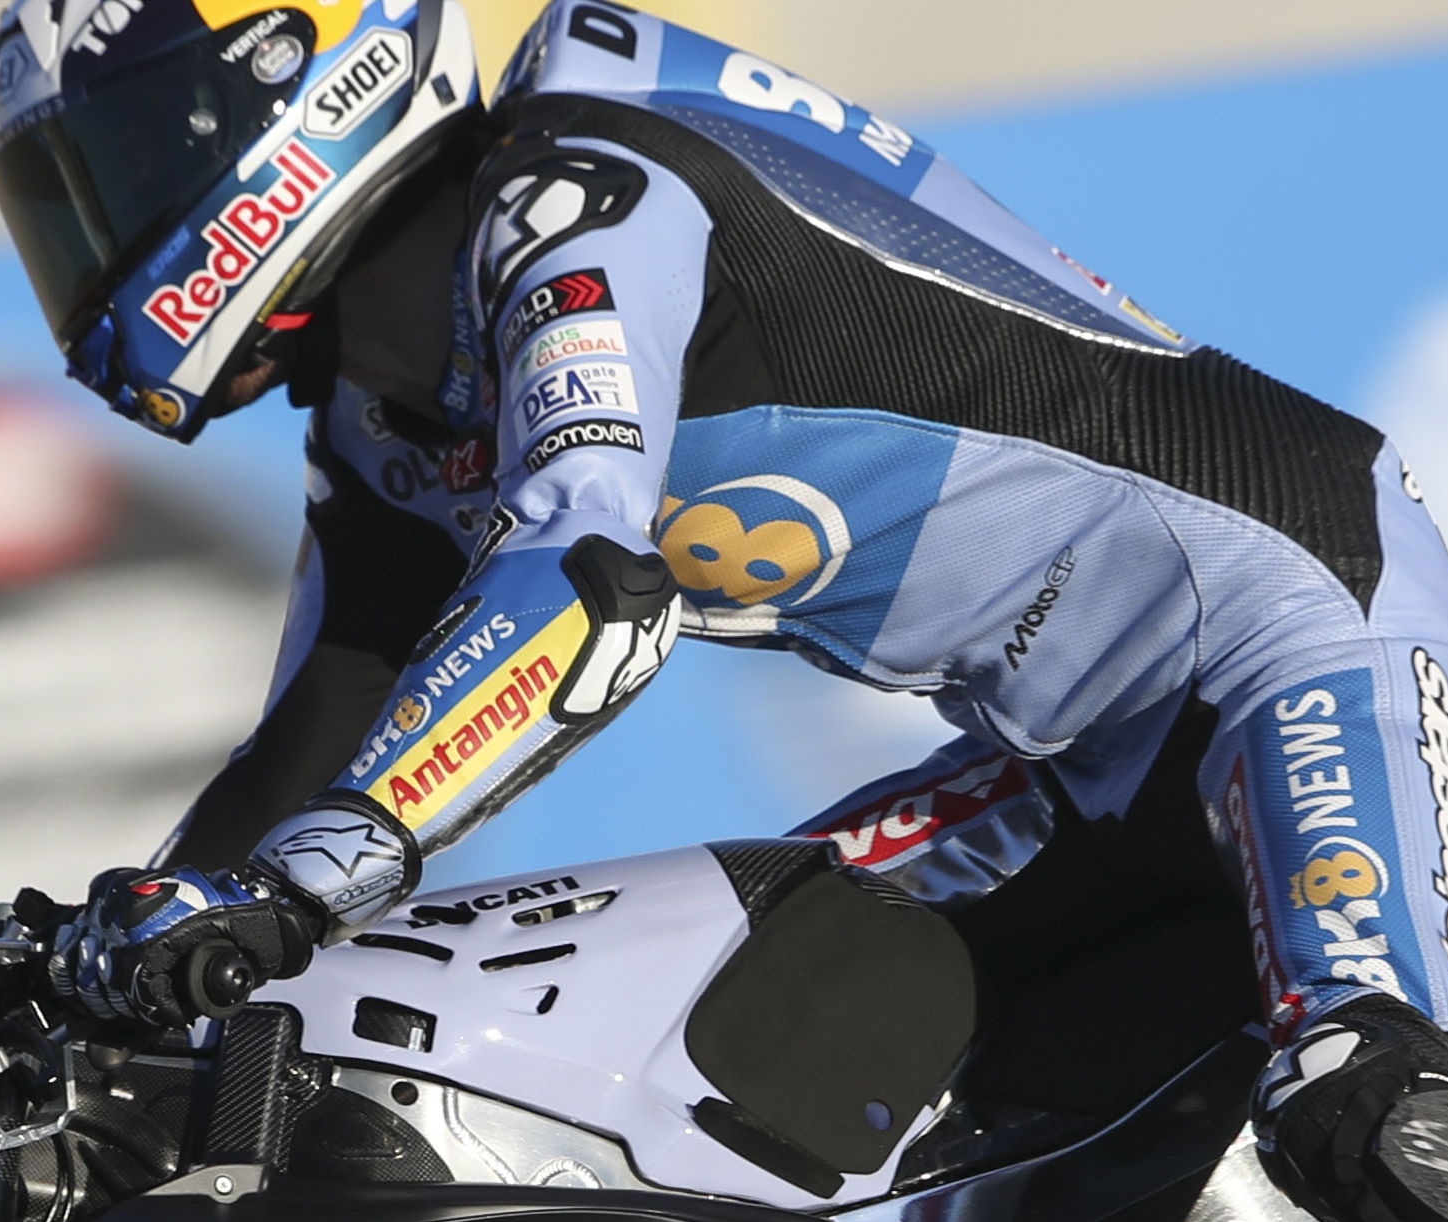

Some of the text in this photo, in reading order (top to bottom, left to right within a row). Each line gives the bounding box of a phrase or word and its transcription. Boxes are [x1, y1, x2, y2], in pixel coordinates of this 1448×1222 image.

[315, 38, 401, 126] SHOEI
[535, 338, 624, 368] GLOBAL
[537, 327, 581, 351] AUS
[522, 370, 594, 427] DEA
[581, 366, 617, 381] gate
[527, 423, 642, 473] momoven
[424, 612, 518, 700] NEWS
[391, 653, 561, 820] Antangin
[1274, 688, 1359, 835] NEWS
